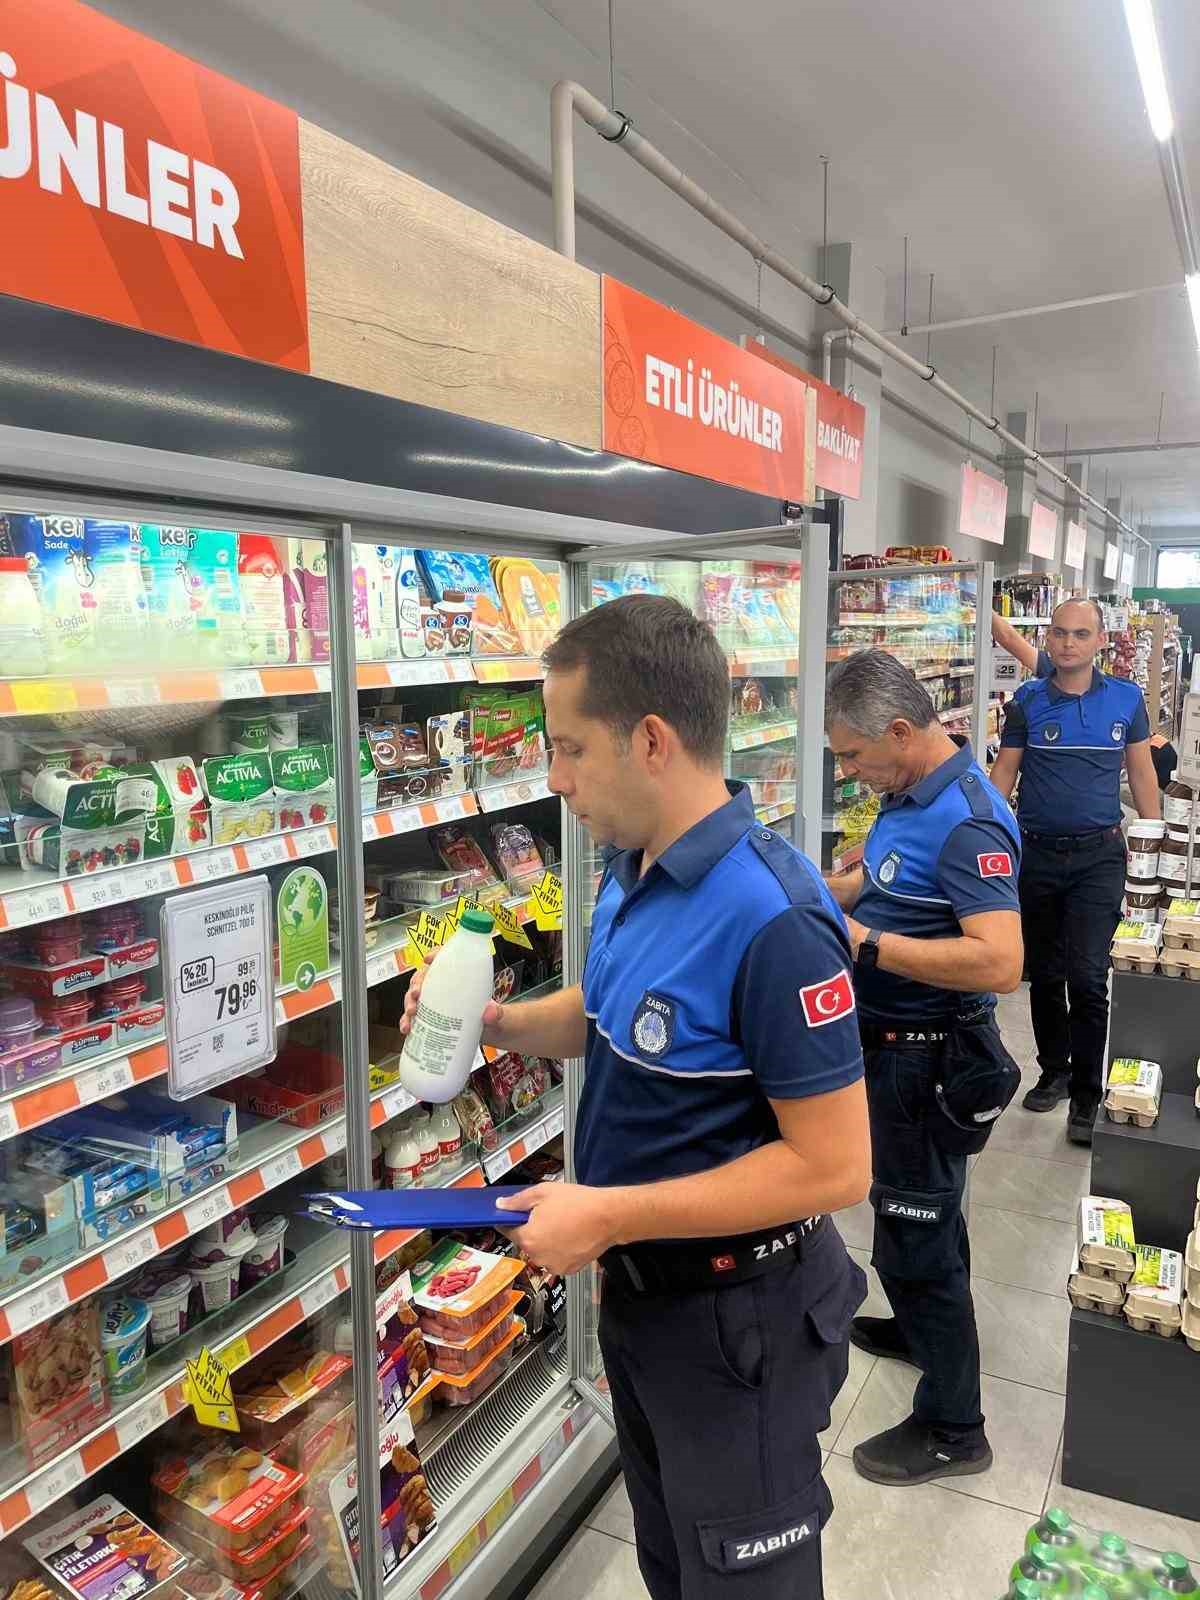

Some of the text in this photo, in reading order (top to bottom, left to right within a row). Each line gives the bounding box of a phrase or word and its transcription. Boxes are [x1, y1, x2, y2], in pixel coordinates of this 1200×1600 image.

[645, 353, 783, 453] ETLİ ÜRÜNLER
[817, 419, 862, 463] BAKLİYAT
[44, 540, 68, 550] Sade
[215, 765, 263, 785] ACTIVIA
[281, 758, 322, 776] ACTIVIA
[75, 794, 116, 812] ACTI
[645, 996, 671, 1017] ZABITA
[887, 1203, 937, 1219] ZABITA
[736, 1524, 810, 1560] ZABITA
